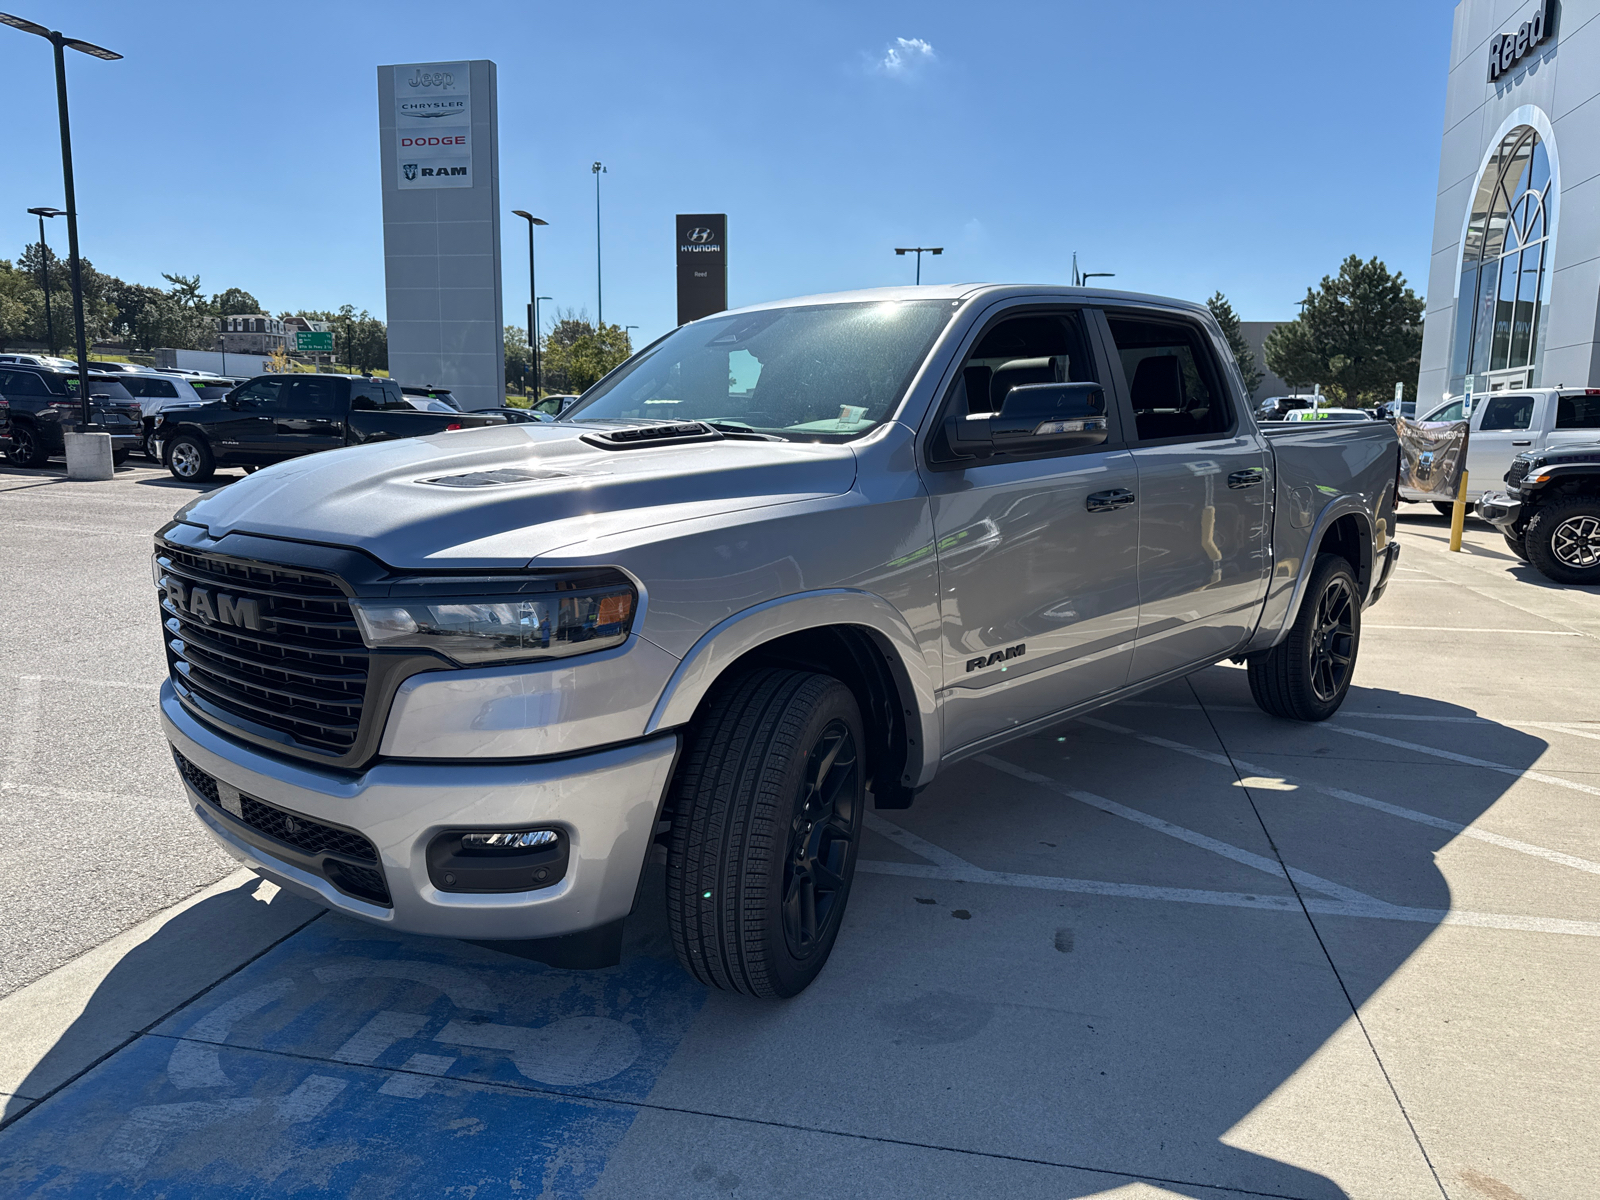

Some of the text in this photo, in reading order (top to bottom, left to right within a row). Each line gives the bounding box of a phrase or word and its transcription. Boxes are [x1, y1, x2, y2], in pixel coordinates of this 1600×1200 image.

[1487, 0, 1553, 83] Reed
[408, 69, 454, 89] Jeep
[402, 101, 464, 109] CHRYSLER
[401, 135, 466, 147] DODGE
[421, 166, 467, 176] RAM
[681, 244, 720, 252] HYUNDAI
[611, 425, 677, 442] 1500
[165, 576, 261, 631] RAM
[965, 643, 1026, 672] RAM
